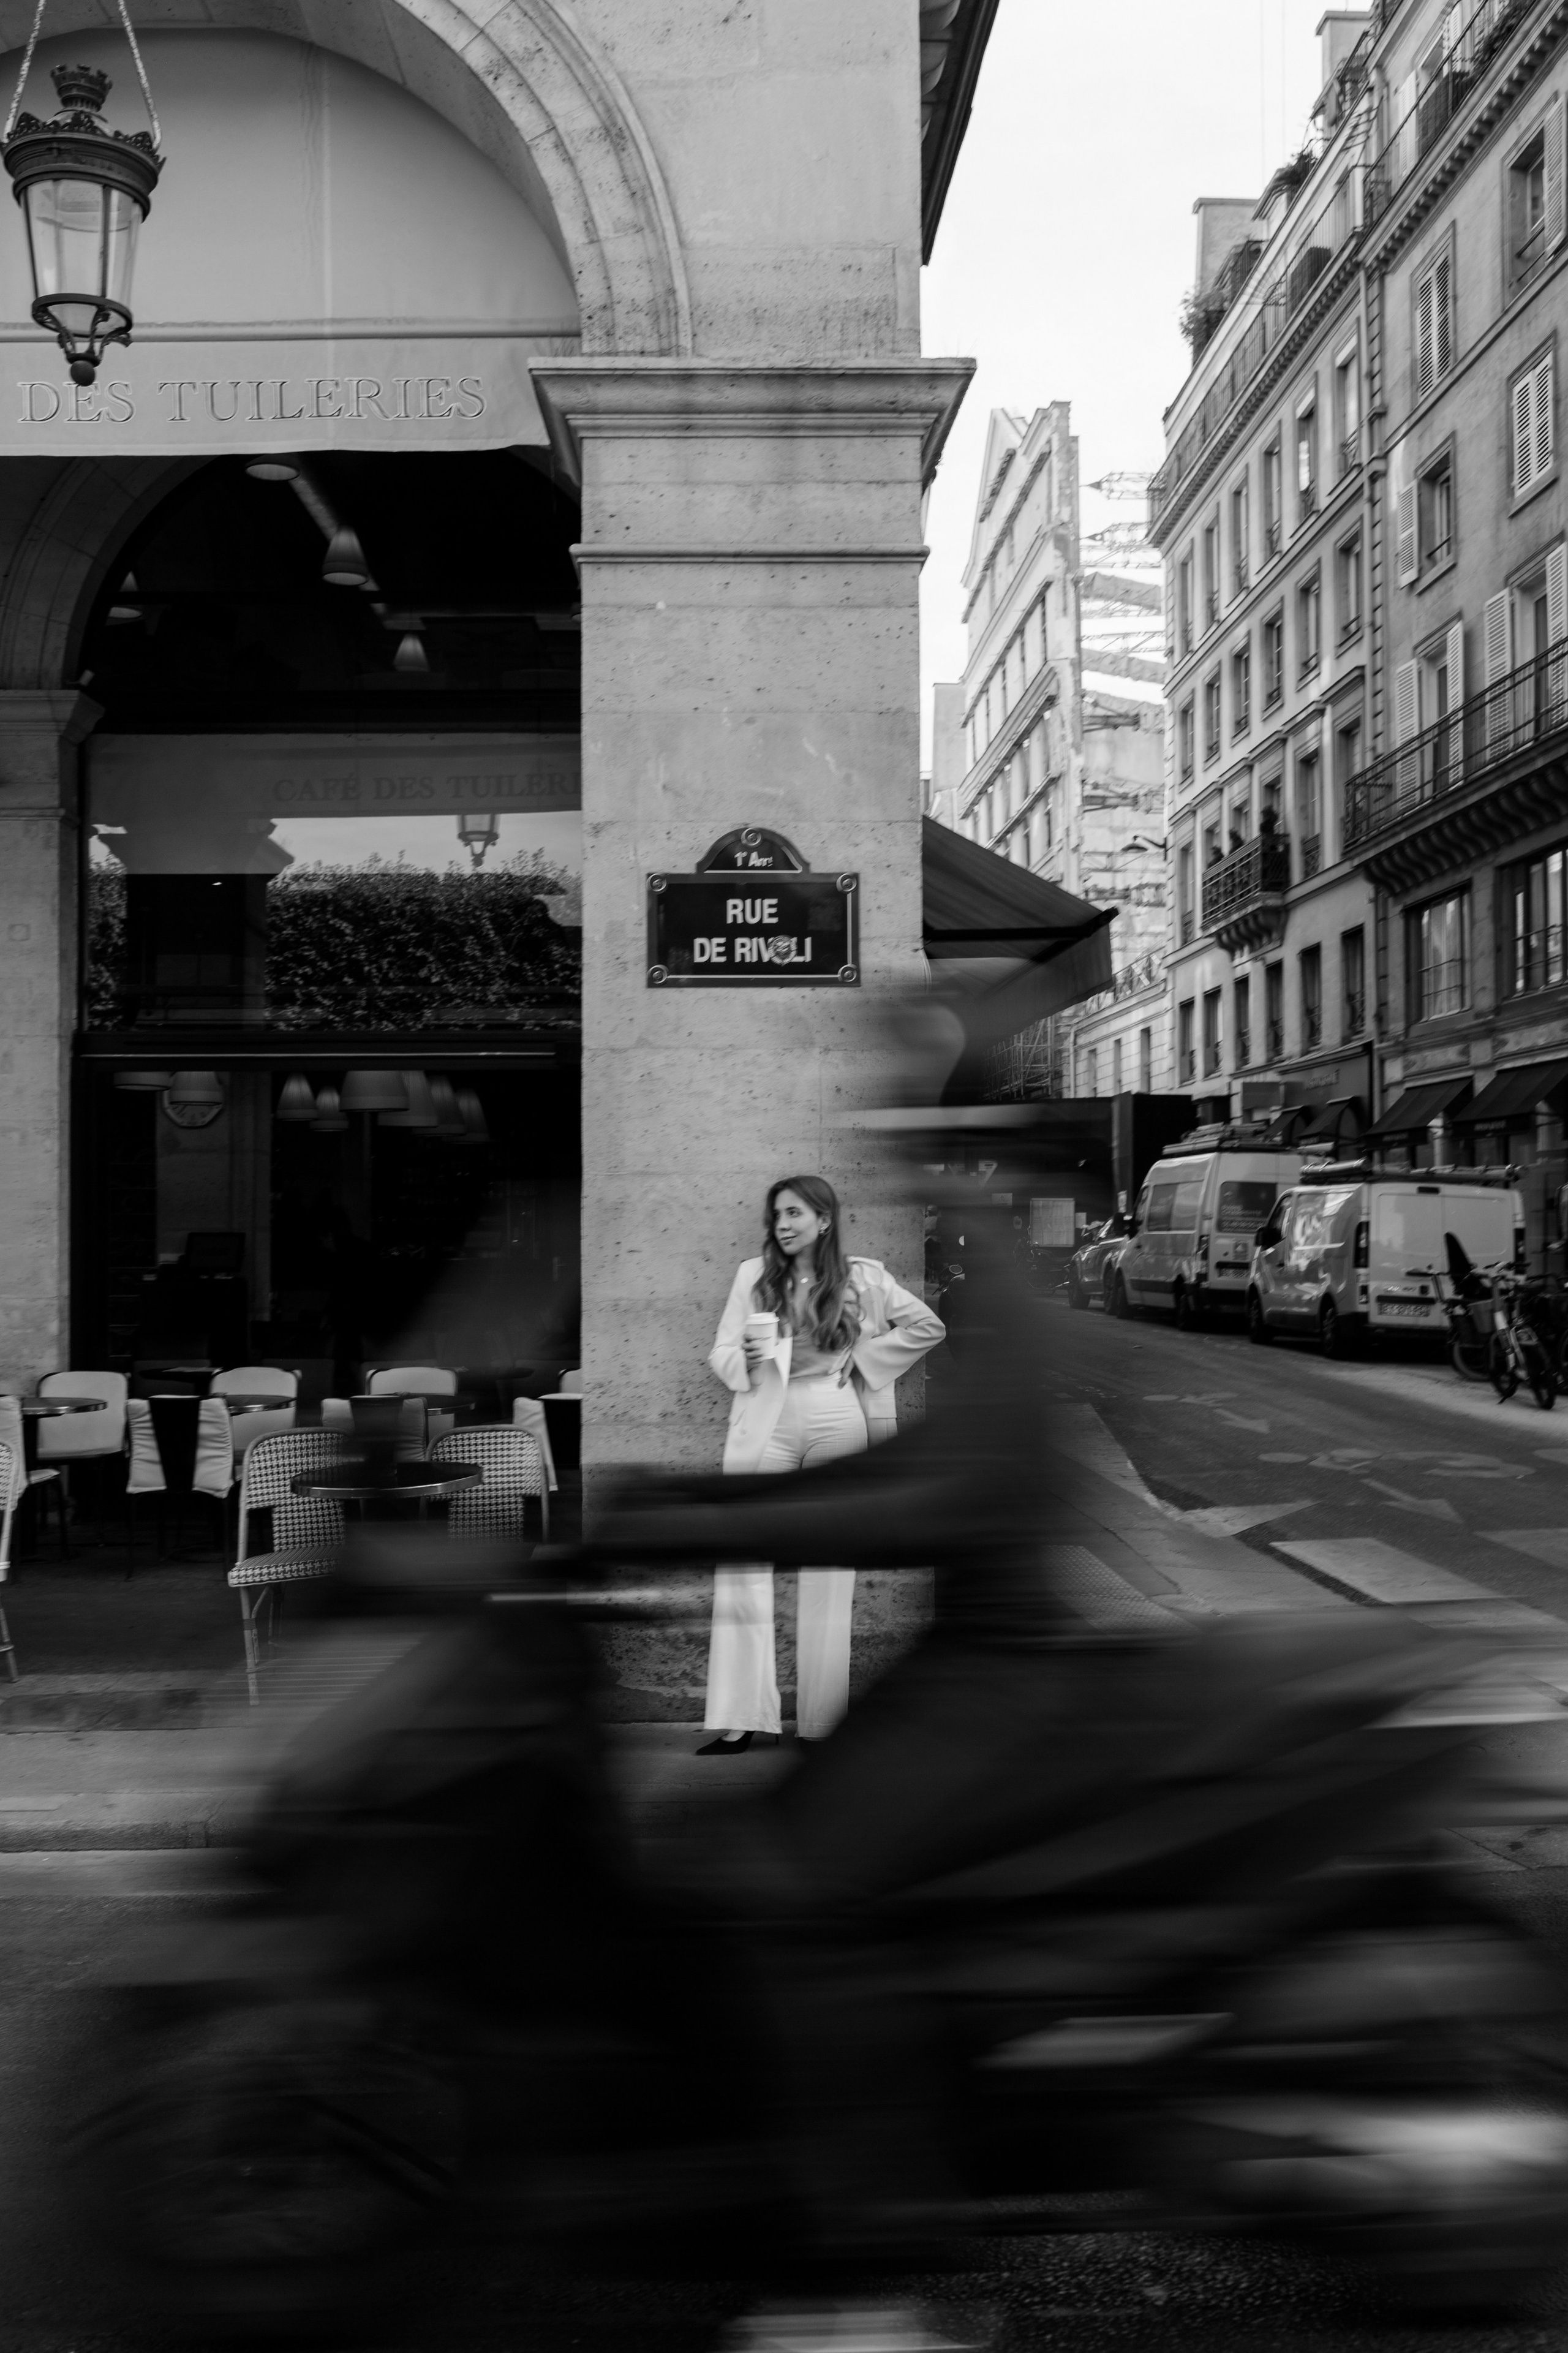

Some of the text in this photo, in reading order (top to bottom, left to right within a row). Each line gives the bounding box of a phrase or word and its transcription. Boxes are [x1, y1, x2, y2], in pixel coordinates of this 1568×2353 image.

[17, 376, 488, 423] DES TUILERIES
[272, 772, 364, 802] CAFÉ
[372, 776, 436, 800] DES
[726, 898, 778, 924] RUE
[693, 937, 812, 963] DE RIVLI
